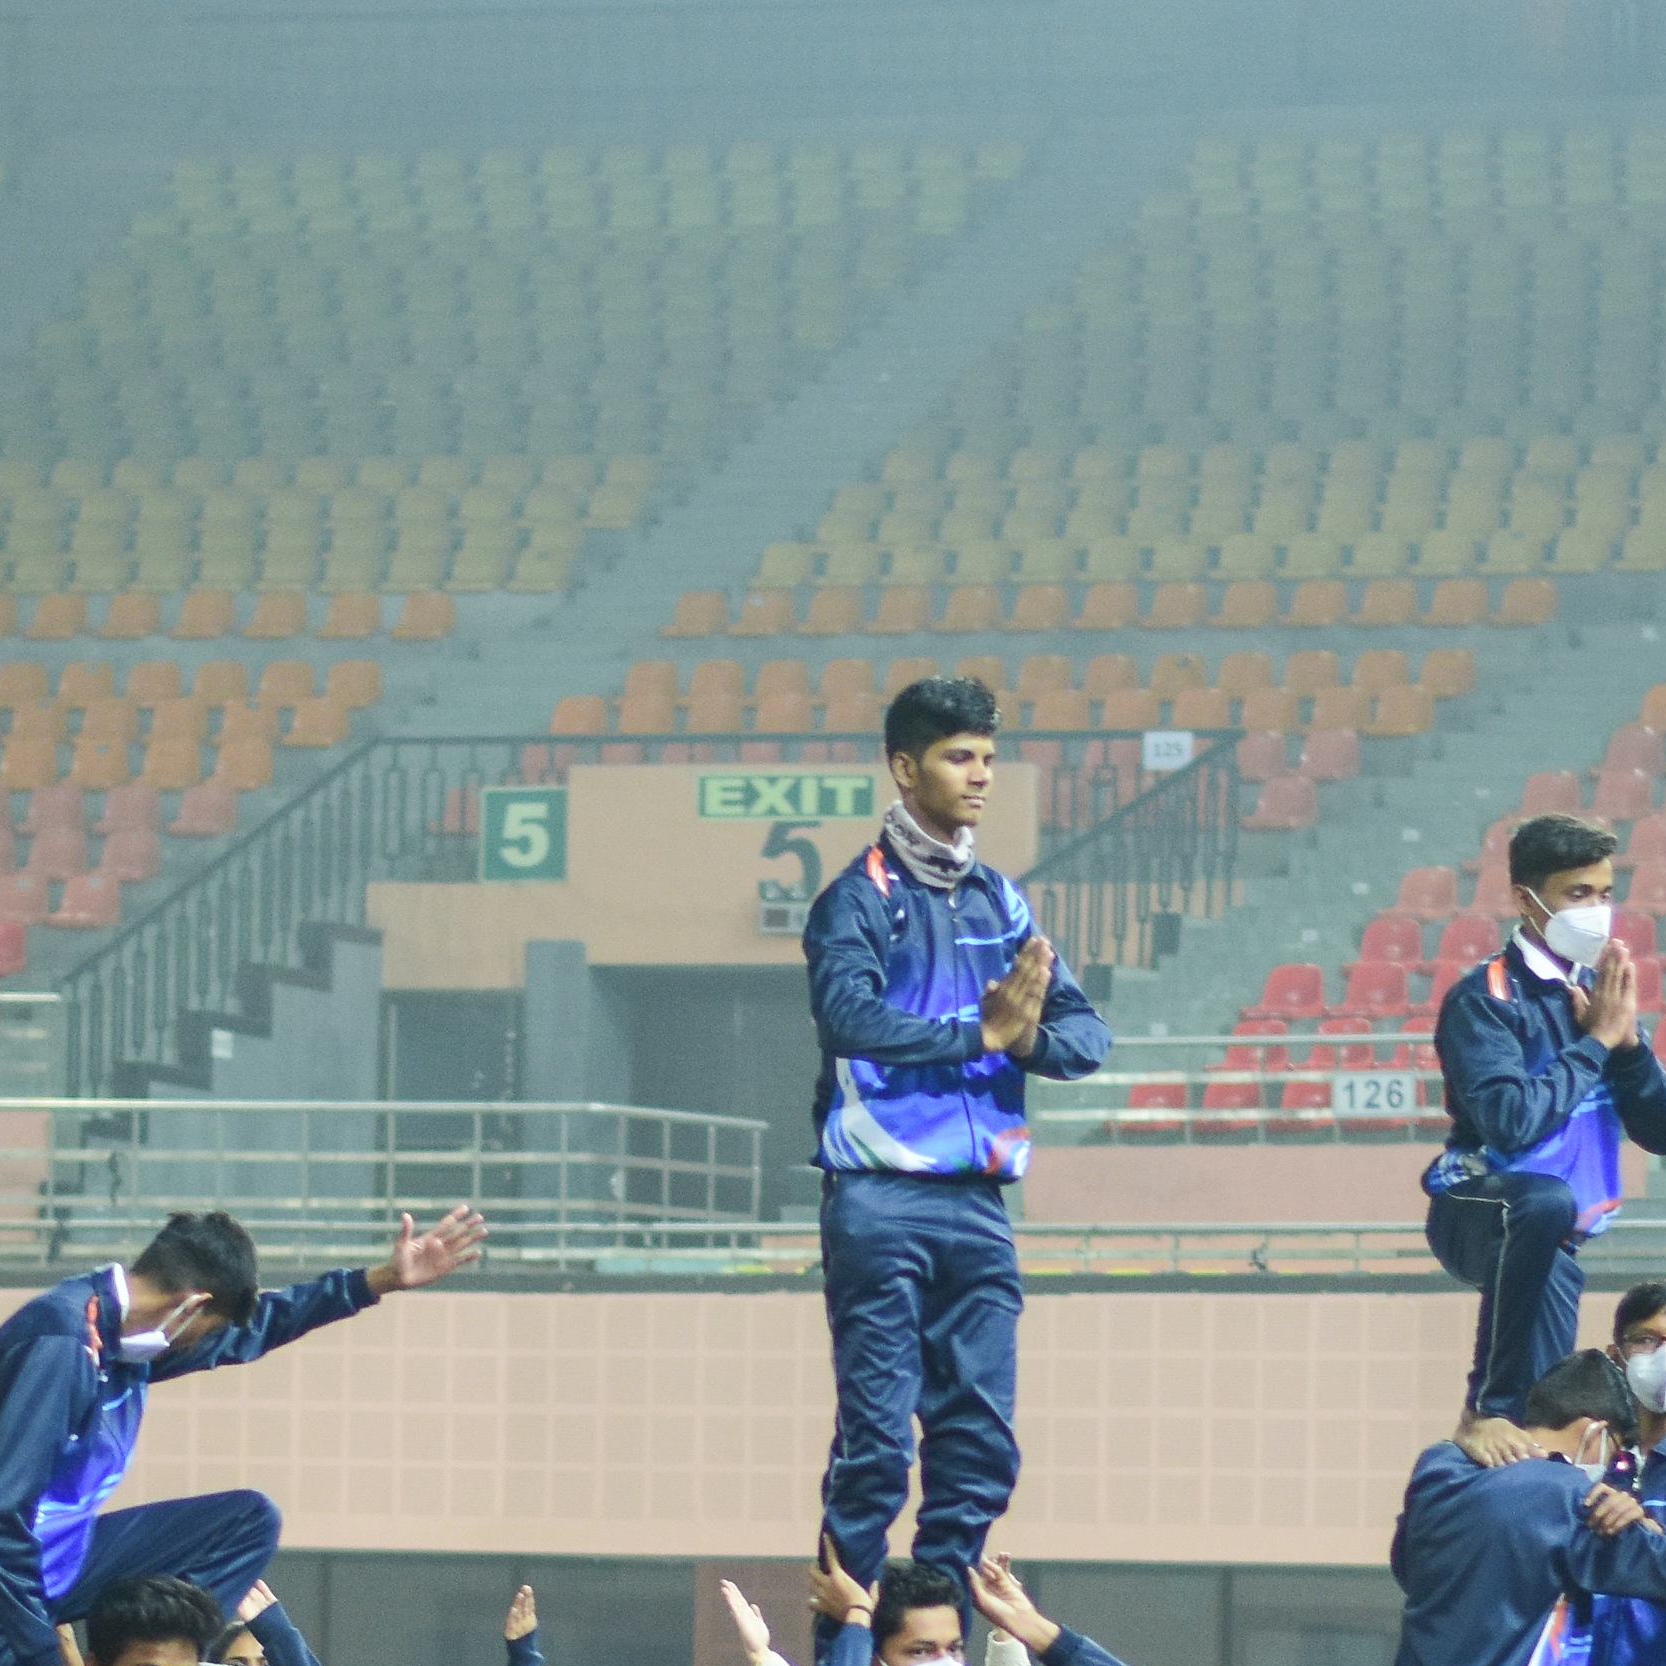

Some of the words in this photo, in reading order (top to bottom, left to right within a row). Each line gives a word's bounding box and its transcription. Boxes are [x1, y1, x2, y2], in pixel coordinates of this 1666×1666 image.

[704, 777, 869, 815] EXIT
[498, 802, 550, 868] 5
[1342, 1079, 1404, 1109] 126
